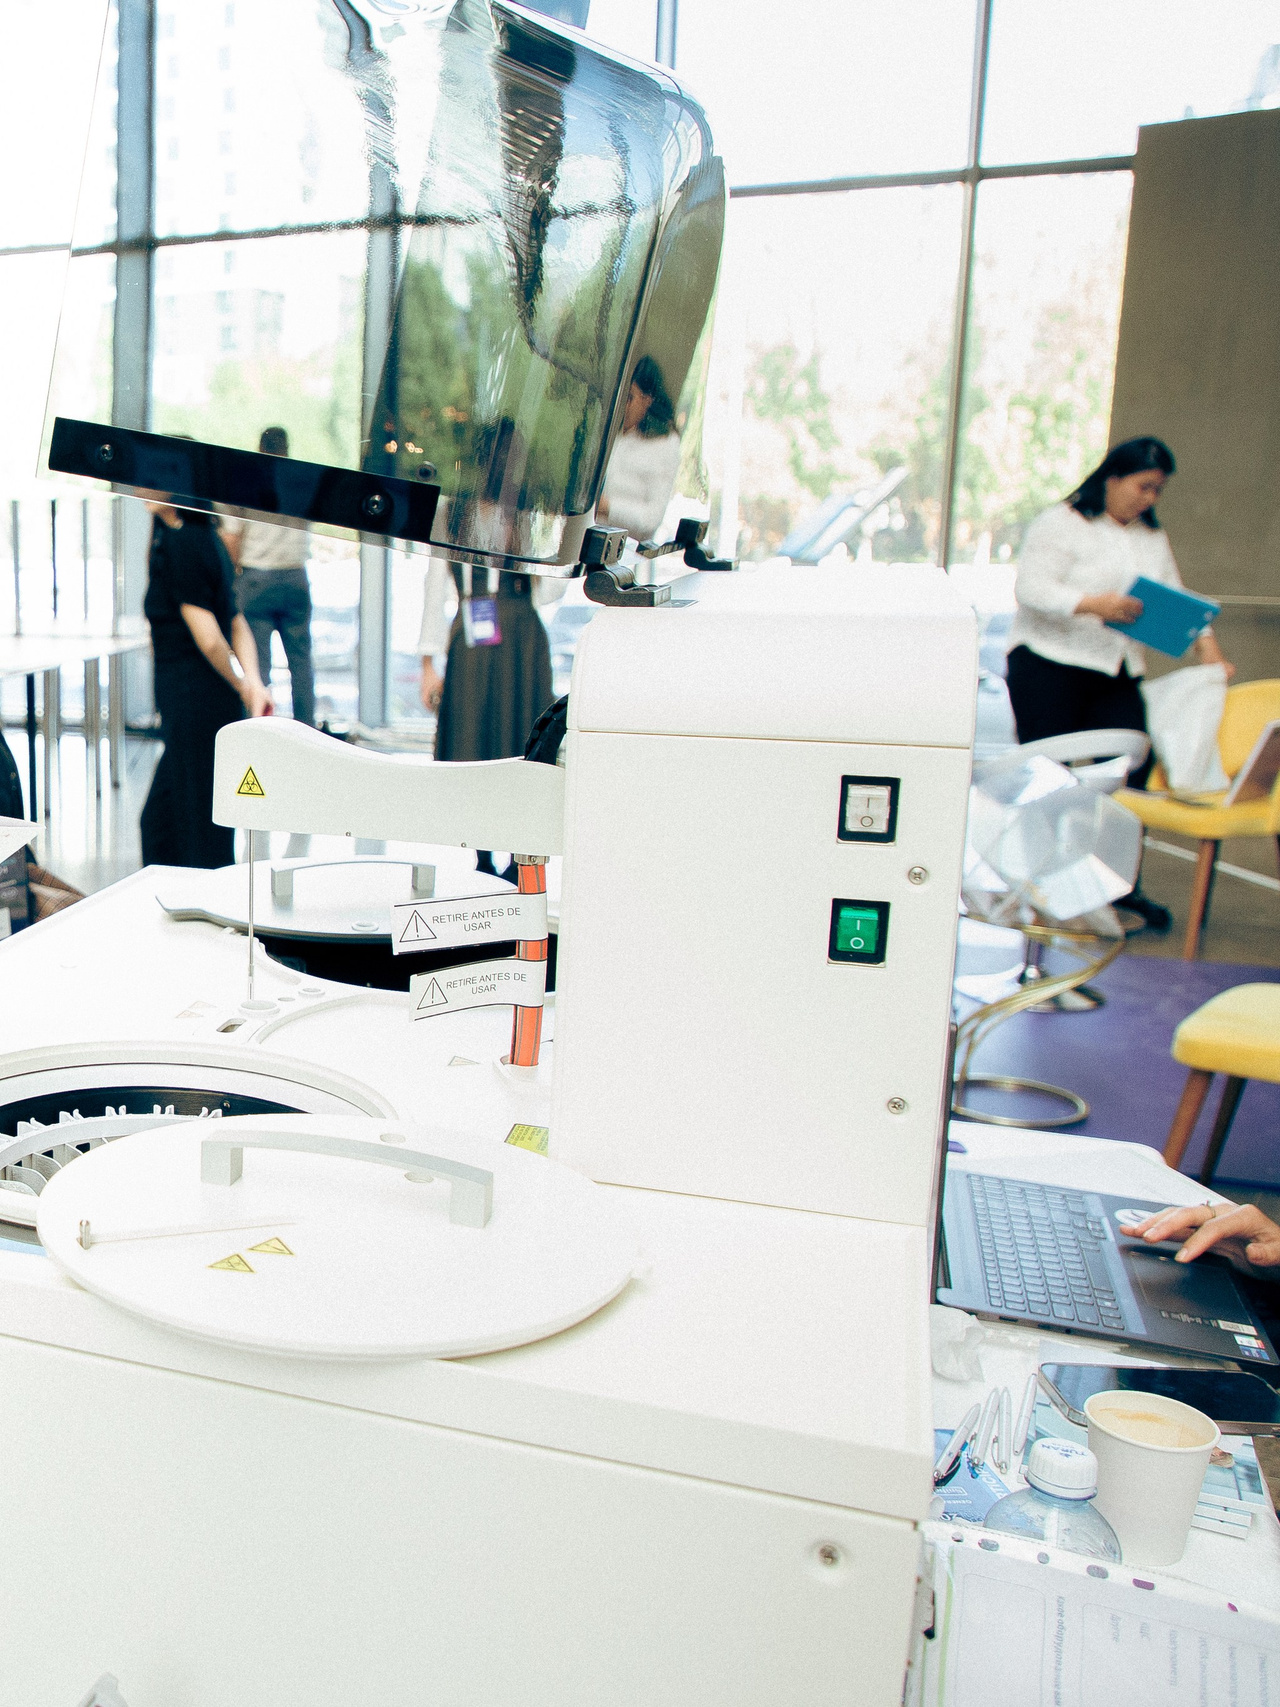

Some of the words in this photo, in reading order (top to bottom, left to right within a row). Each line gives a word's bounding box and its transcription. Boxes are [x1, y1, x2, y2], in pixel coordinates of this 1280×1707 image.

[432, 912, 469, 924] RETIRE
[471, 908, 504, 920] ANTES
[507, 907, 521, 916] DE
[463, 921, 492, 932] USAR
[446, 975, 477, 989] RETIRE
[479, 972, 511, 984] ANTES
[513, 973, 527, 983] DE
[471, 984, 497, 995] USAR
[1041, 1443, 1088, 1457] TURAN
